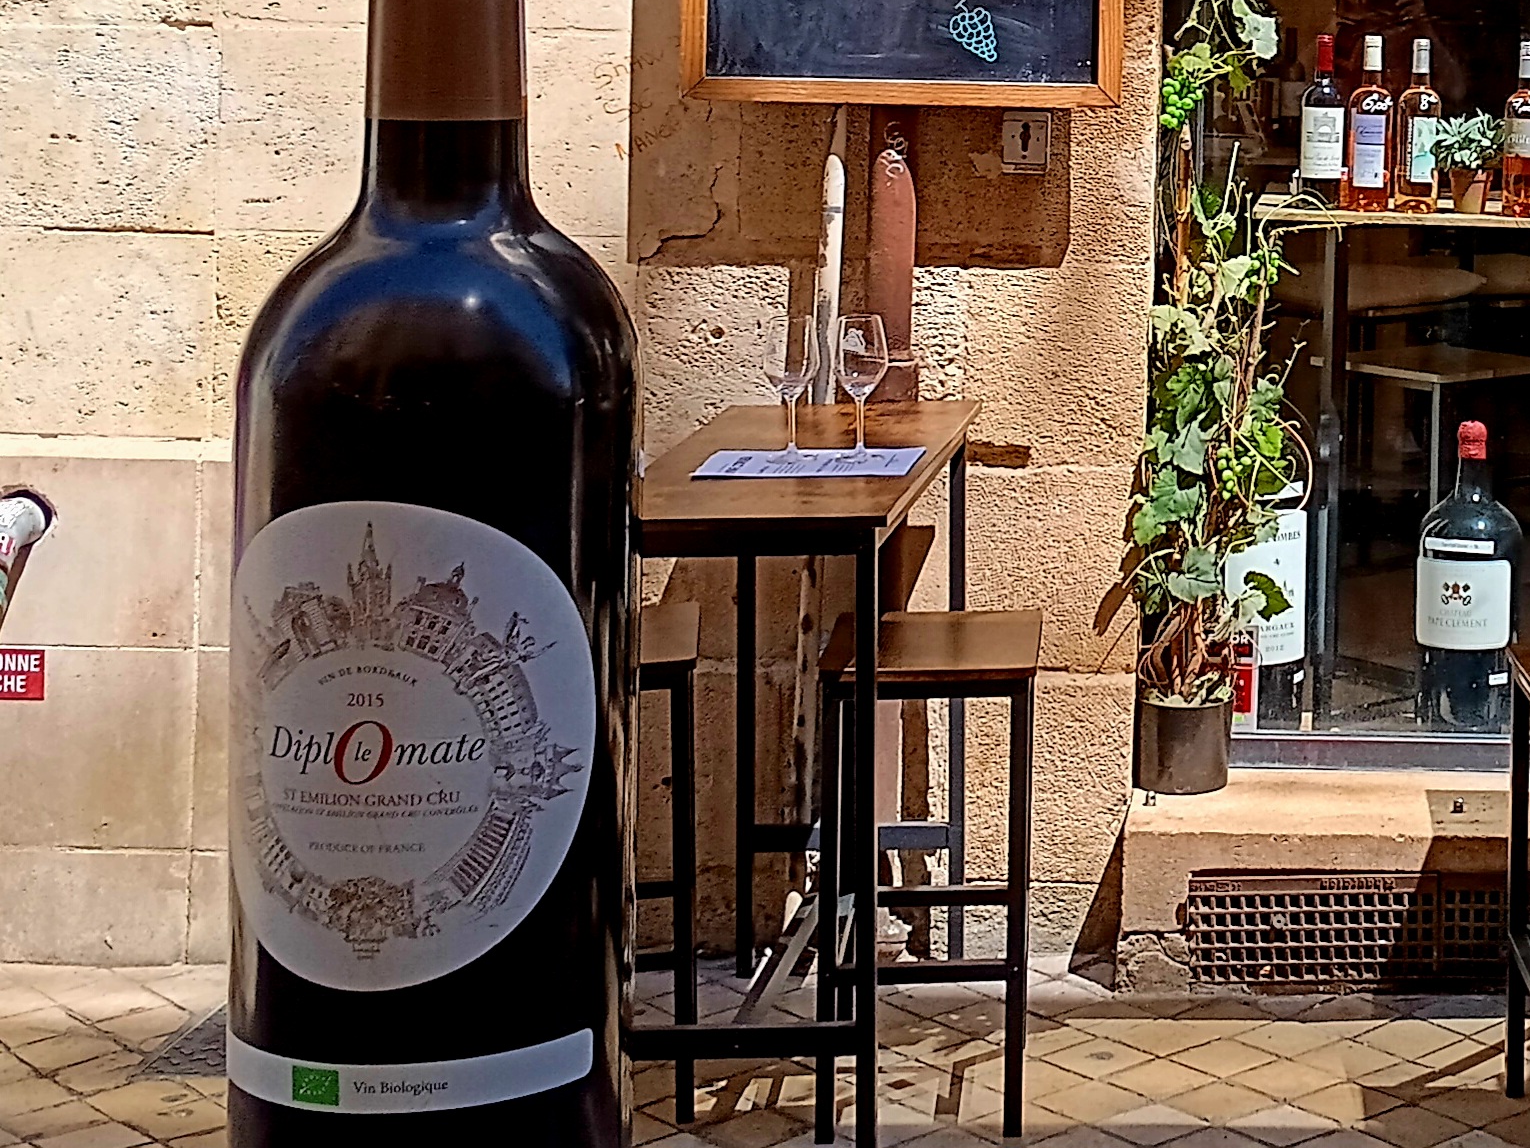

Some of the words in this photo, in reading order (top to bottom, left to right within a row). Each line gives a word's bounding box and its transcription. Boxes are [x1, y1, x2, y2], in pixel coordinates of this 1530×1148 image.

[1260, 622, 1295, 633] ARGAUX
[338, 666, 352, 678] DE
[356, 665, 419, 688] BORDEAUX
[347, 692, 385, 708] 2015
[354, 741, 372, 762] le
[283, 789, 296, 801] ST
[300, 790, 361, 806] EMILION
[364, 793, 422, 807] GRAND
[426, 790, 460, 805] CRU
[378, 842, 426, 853] FRANCE
[353, 1080, 376, 1095] Vin
[379, 1077, 449, 1100] Biologique
